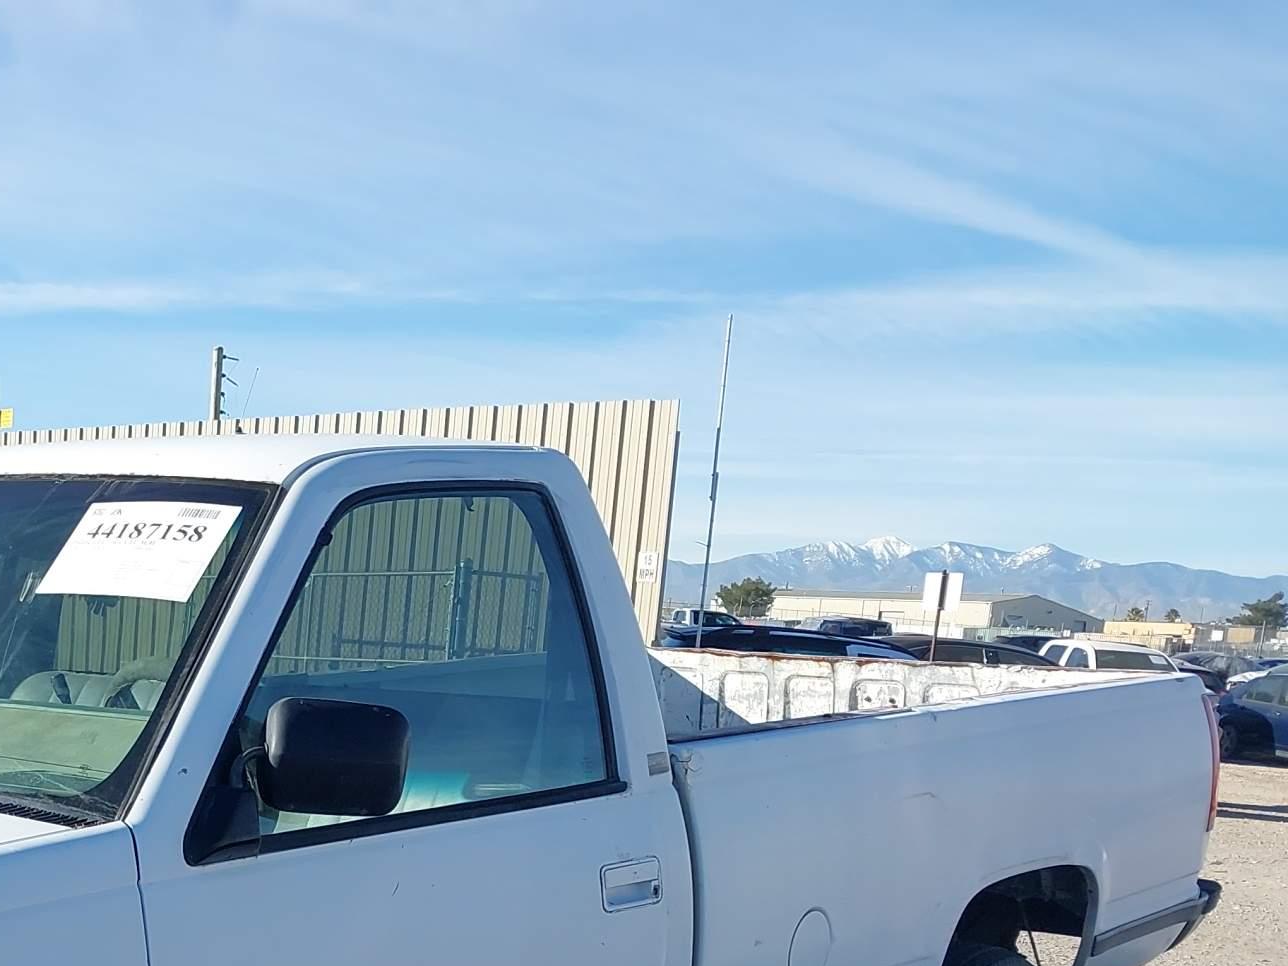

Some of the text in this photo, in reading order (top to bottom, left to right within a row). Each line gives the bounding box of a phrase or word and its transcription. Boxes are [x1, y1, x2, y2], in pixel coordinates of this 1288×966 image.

[88, 522, 208, 543] 44187158
[645, 554, 653, 566] 15
[640, 568, 654, 579] MPH
